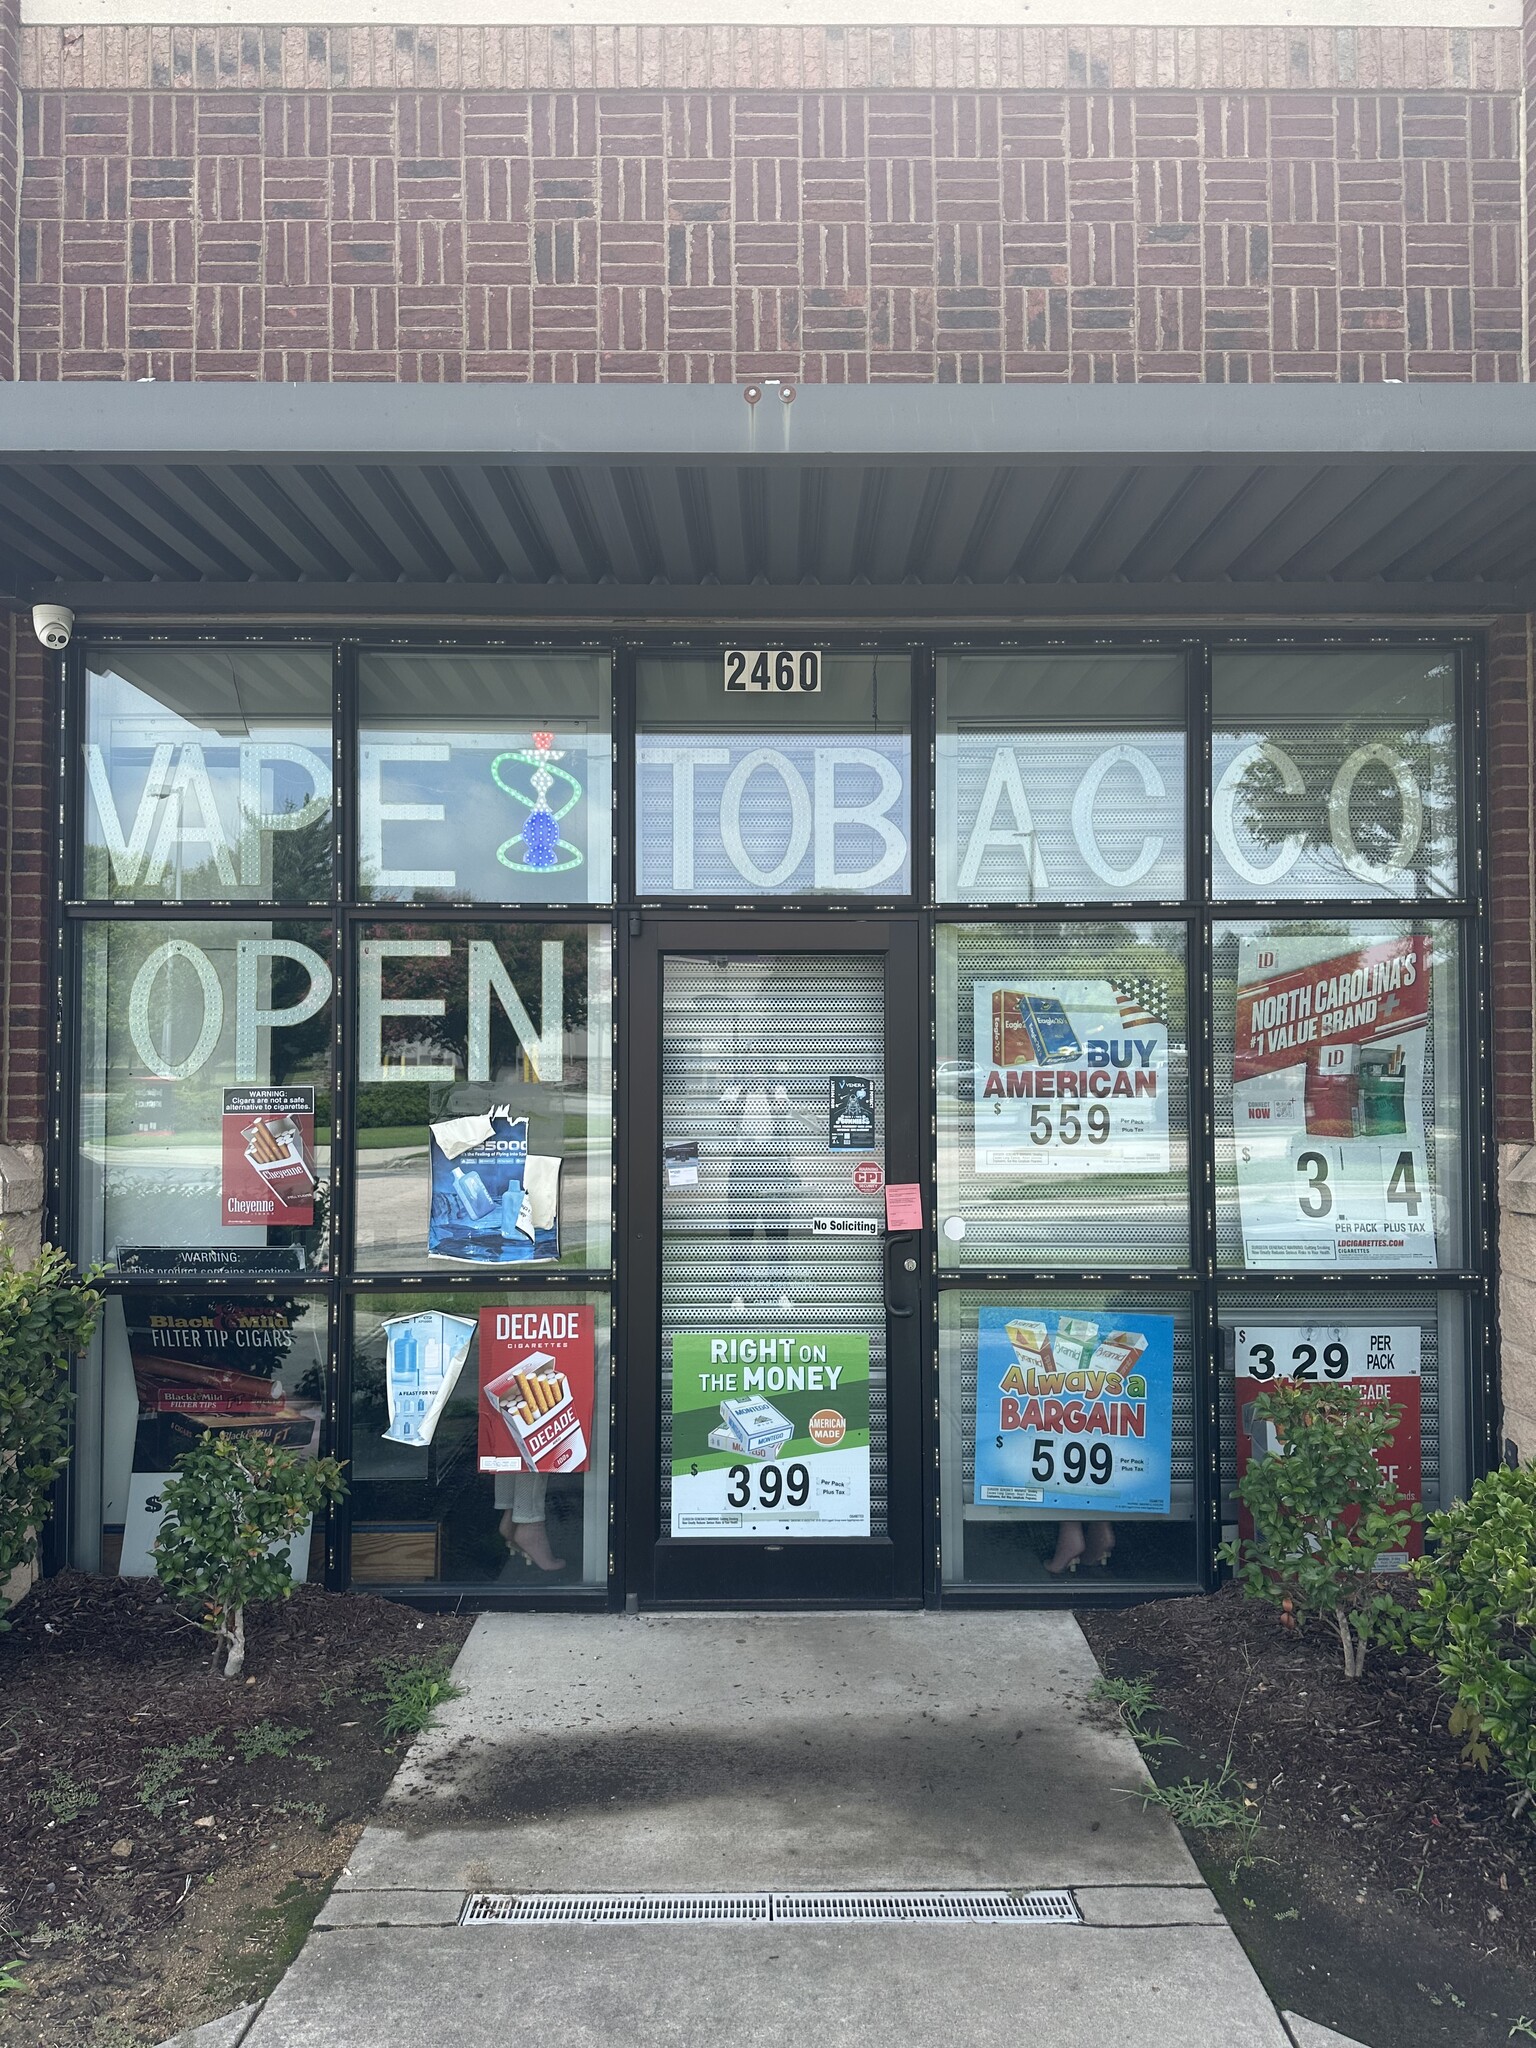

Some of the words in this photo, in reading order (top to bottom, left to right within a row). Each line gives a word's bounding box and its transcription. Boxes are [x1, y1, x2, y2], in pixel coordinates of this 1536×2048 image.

[727, 651, 819, 691] 2460
[81, 742, 456, 887] VAPE
[640, 743, 1423, 890] TOBACCO
[1258, 952, 1274, 968] LD
[1252, 985, 1311, 1033] NORTH
[1315, 953, 1416, 1014] CAROLINA'S
[129, 939, 563, 1082] OPEN
[1250, 1032, 1264, 1056] #1
[1268, 1017, 1318, 1053] VALUE
[1321, 1000, 1377, 1037] BRAND
[1088, 1040, 1157, 1068] BUY
[983, 1071, 1157, 1098] AMERICAN
[994, 1102, 1001, 1115] $
[1249, 1108, 1270, 1119] NOW
[1242, 1147, 1251, 1164] $
[262, 1166, 304, 1180] Cheyenne
[855, 1173, 882, 1182] CPI
[228, 1197, 275, 1215] Cheyenne
[813, 1220, 827, 1231] No
[830, 1221, 876, 1234] Soliciting
[1335, 1223, 1352, 1232] PER
[1354, 1223, 1378, 1232] PACK
[1384, 1223, 1406, 1232] PLUS
[1409, 1223, 1426, 1232] TAX
[181, 1252, 240, 1263] WARNING:
[150, 1316, 213, 1328] Black
[239, 1315, 289, 1328] Mild
[496, 1313, 580, 1340] DECADE
[152, 1330, 202, 1347] FILTER
[205, 1330, 229, 1347] TIP
[236, 1330, 293, 1347] CIGARS
[1239, 1330, 1246, 1344] $
[1370, 1335, 1391, 1351] PER
[711, 1338, 796, 1364] RIGHT
[799, 1345, 826, 1364] ON
[1367, 1354, 1395, 1370] PACK
[699, 1374, 737, 1392] THE
[743, 1366, 843, 1392] MONEY
[1000, 1365, 1123, 1400] Always
[1127, 1375, 1146, 1398] a
[735, 1403, 770, 1416] MONTEGO
[1001, 1397, 1145, 1438] BARGAIN
[529, 1407, 575, 1453] DECADE
[809, 1418, 846, 1428] AMERICAN
[815, 1430, 840, 1438] MADE
[996, 1435, 1003, 1448] $
[691, 1463, 699, 1476] $
[145, 1495, 162, 1513] $
